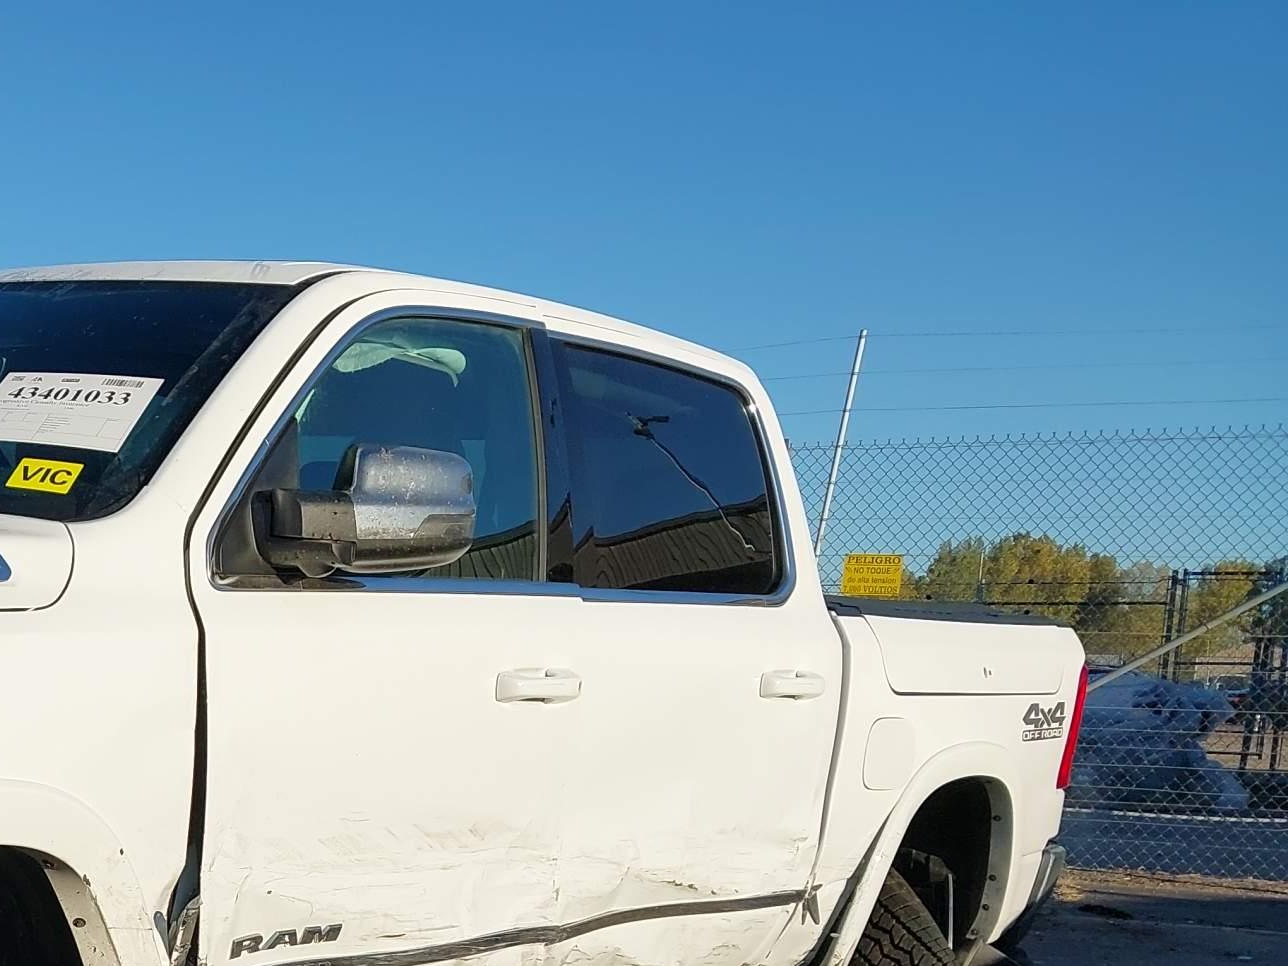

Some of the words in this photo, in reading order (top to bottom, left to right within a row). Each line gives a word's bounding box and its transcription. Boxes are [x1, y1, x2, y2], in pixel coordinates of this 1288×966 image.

[8, 386, 131, 405] 43401033
[21, 465, 74, 485] VIC
[847, 556, 901, 565] PELIGRO
[854, 566, 864, 574] NO
[863, 585, 898, 593] VOLTIOS
[1023, 730, 1042, 740] OFF
[1042, 728, 1062, 738] ROAD
[229, 923, 343, 960] RAM
